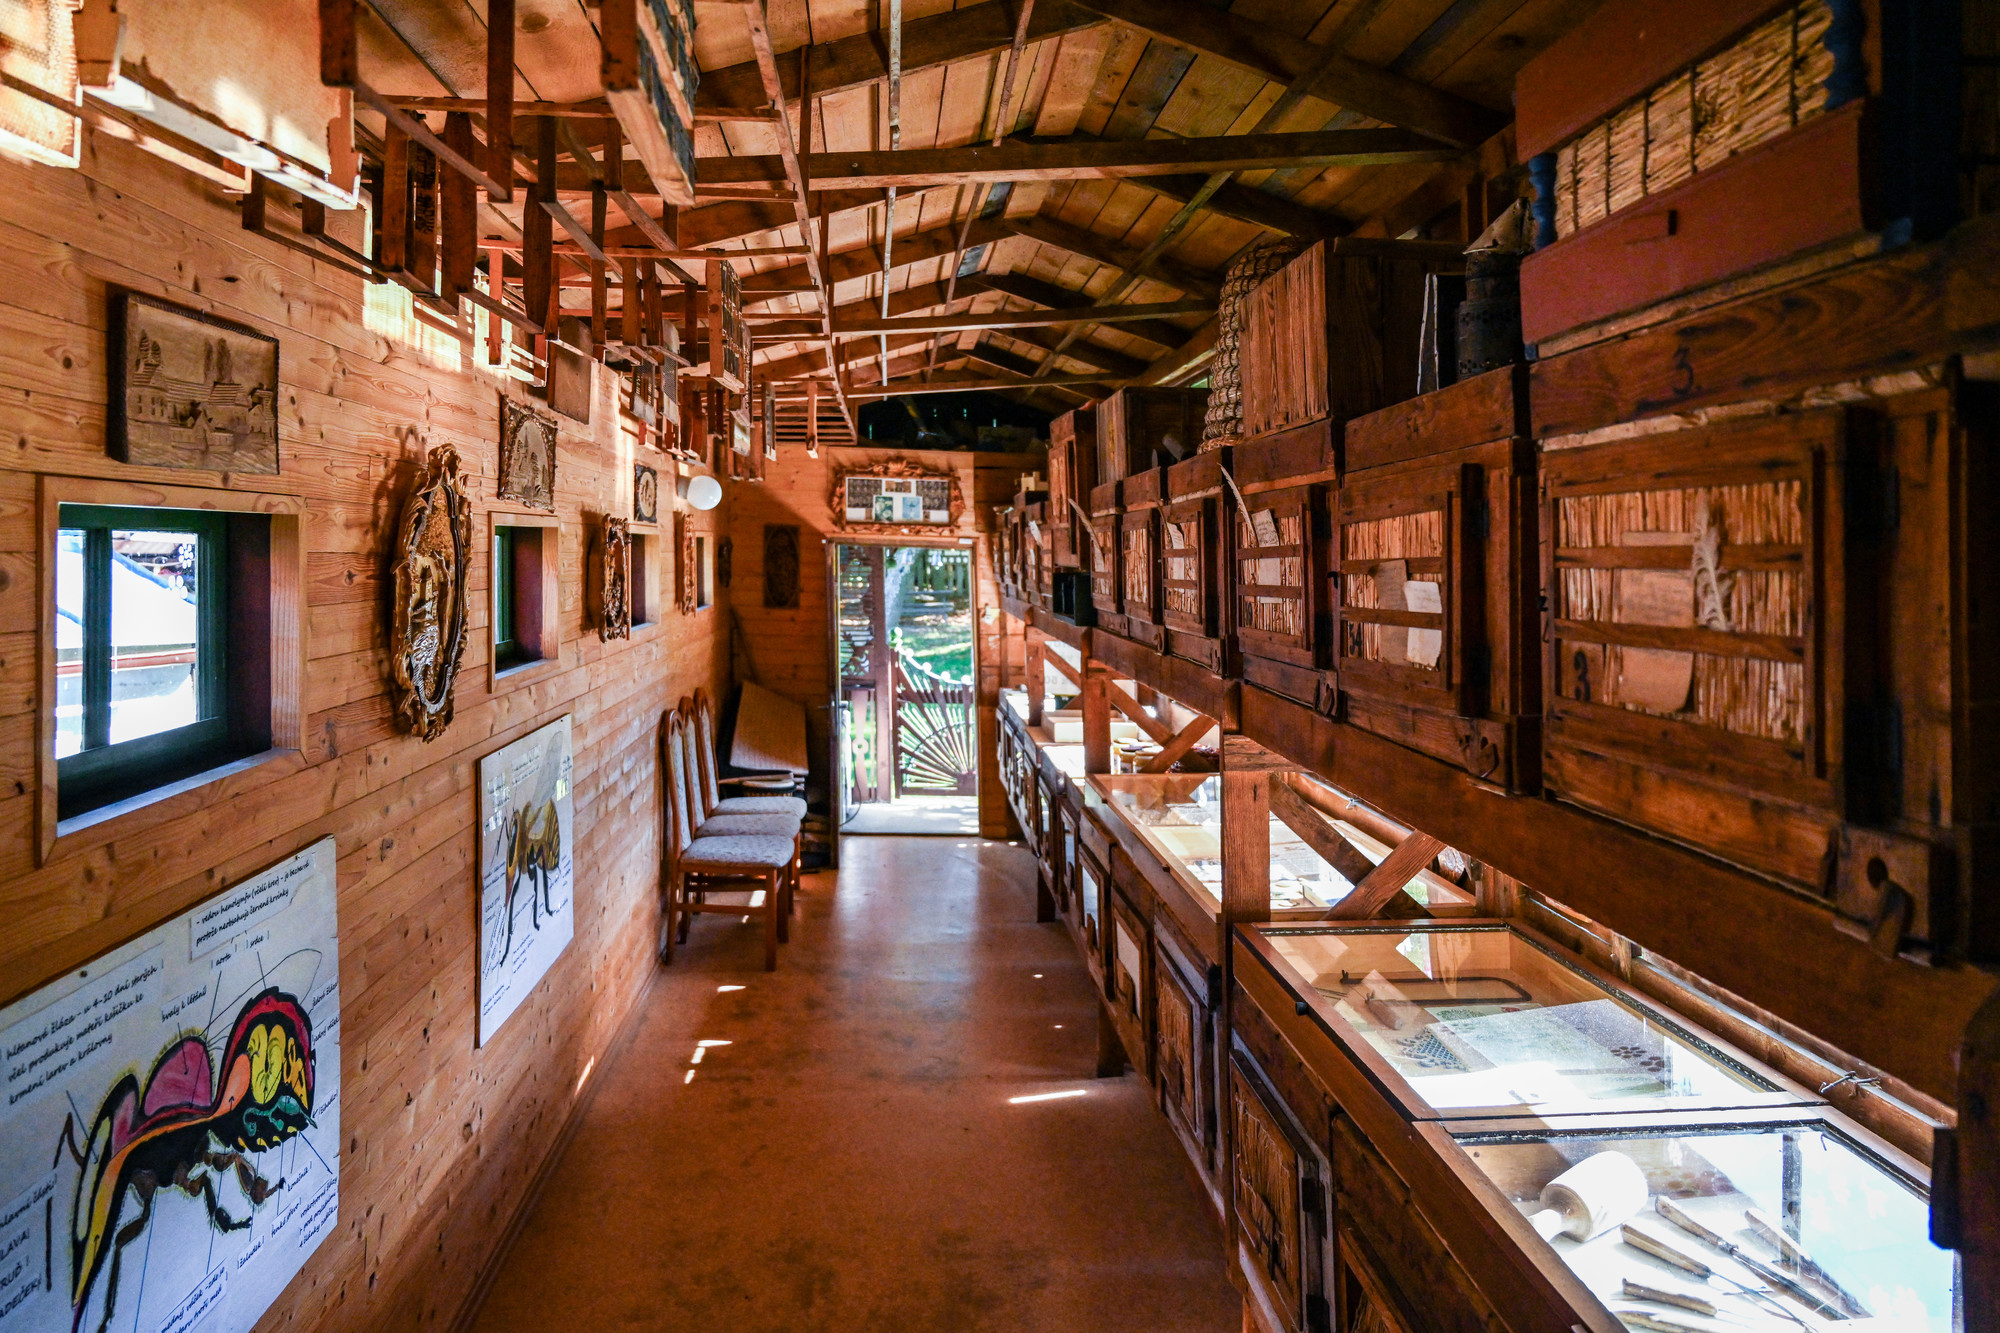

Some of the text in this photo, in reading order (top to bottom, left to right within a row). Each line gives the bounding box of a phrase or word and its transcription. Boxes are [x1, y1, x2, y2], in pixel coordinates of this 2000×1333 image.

[1573, 650, 1591, 701] 3
[0, 1229, 29, 1259] LAVA
[0, 1260, 23, 1290] RUĎ
[0, 1278, 41, 1318] ADEČEK
